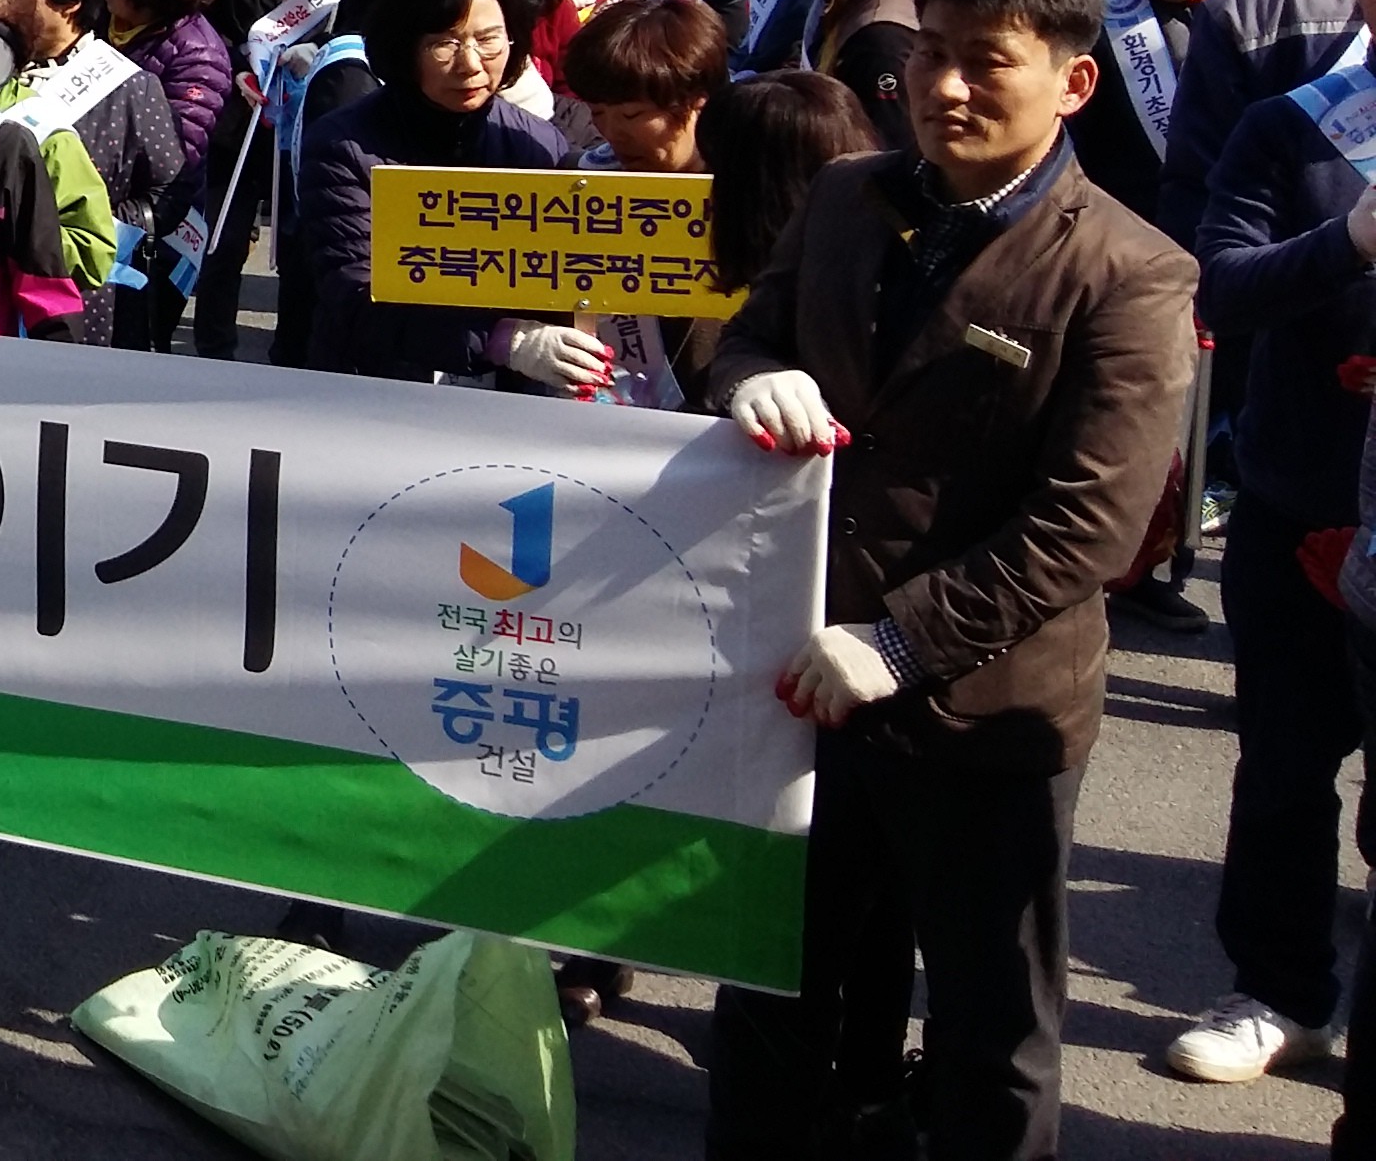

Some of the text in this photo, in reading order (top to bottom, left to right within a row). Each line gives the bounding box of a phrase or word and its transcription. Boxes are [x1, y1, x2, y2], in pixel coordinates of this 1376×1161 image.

[452, 643, 561, 686] 살기좋은
[430, 677, 581, 763] 증평
[476, 742, 537, 784] 건설
